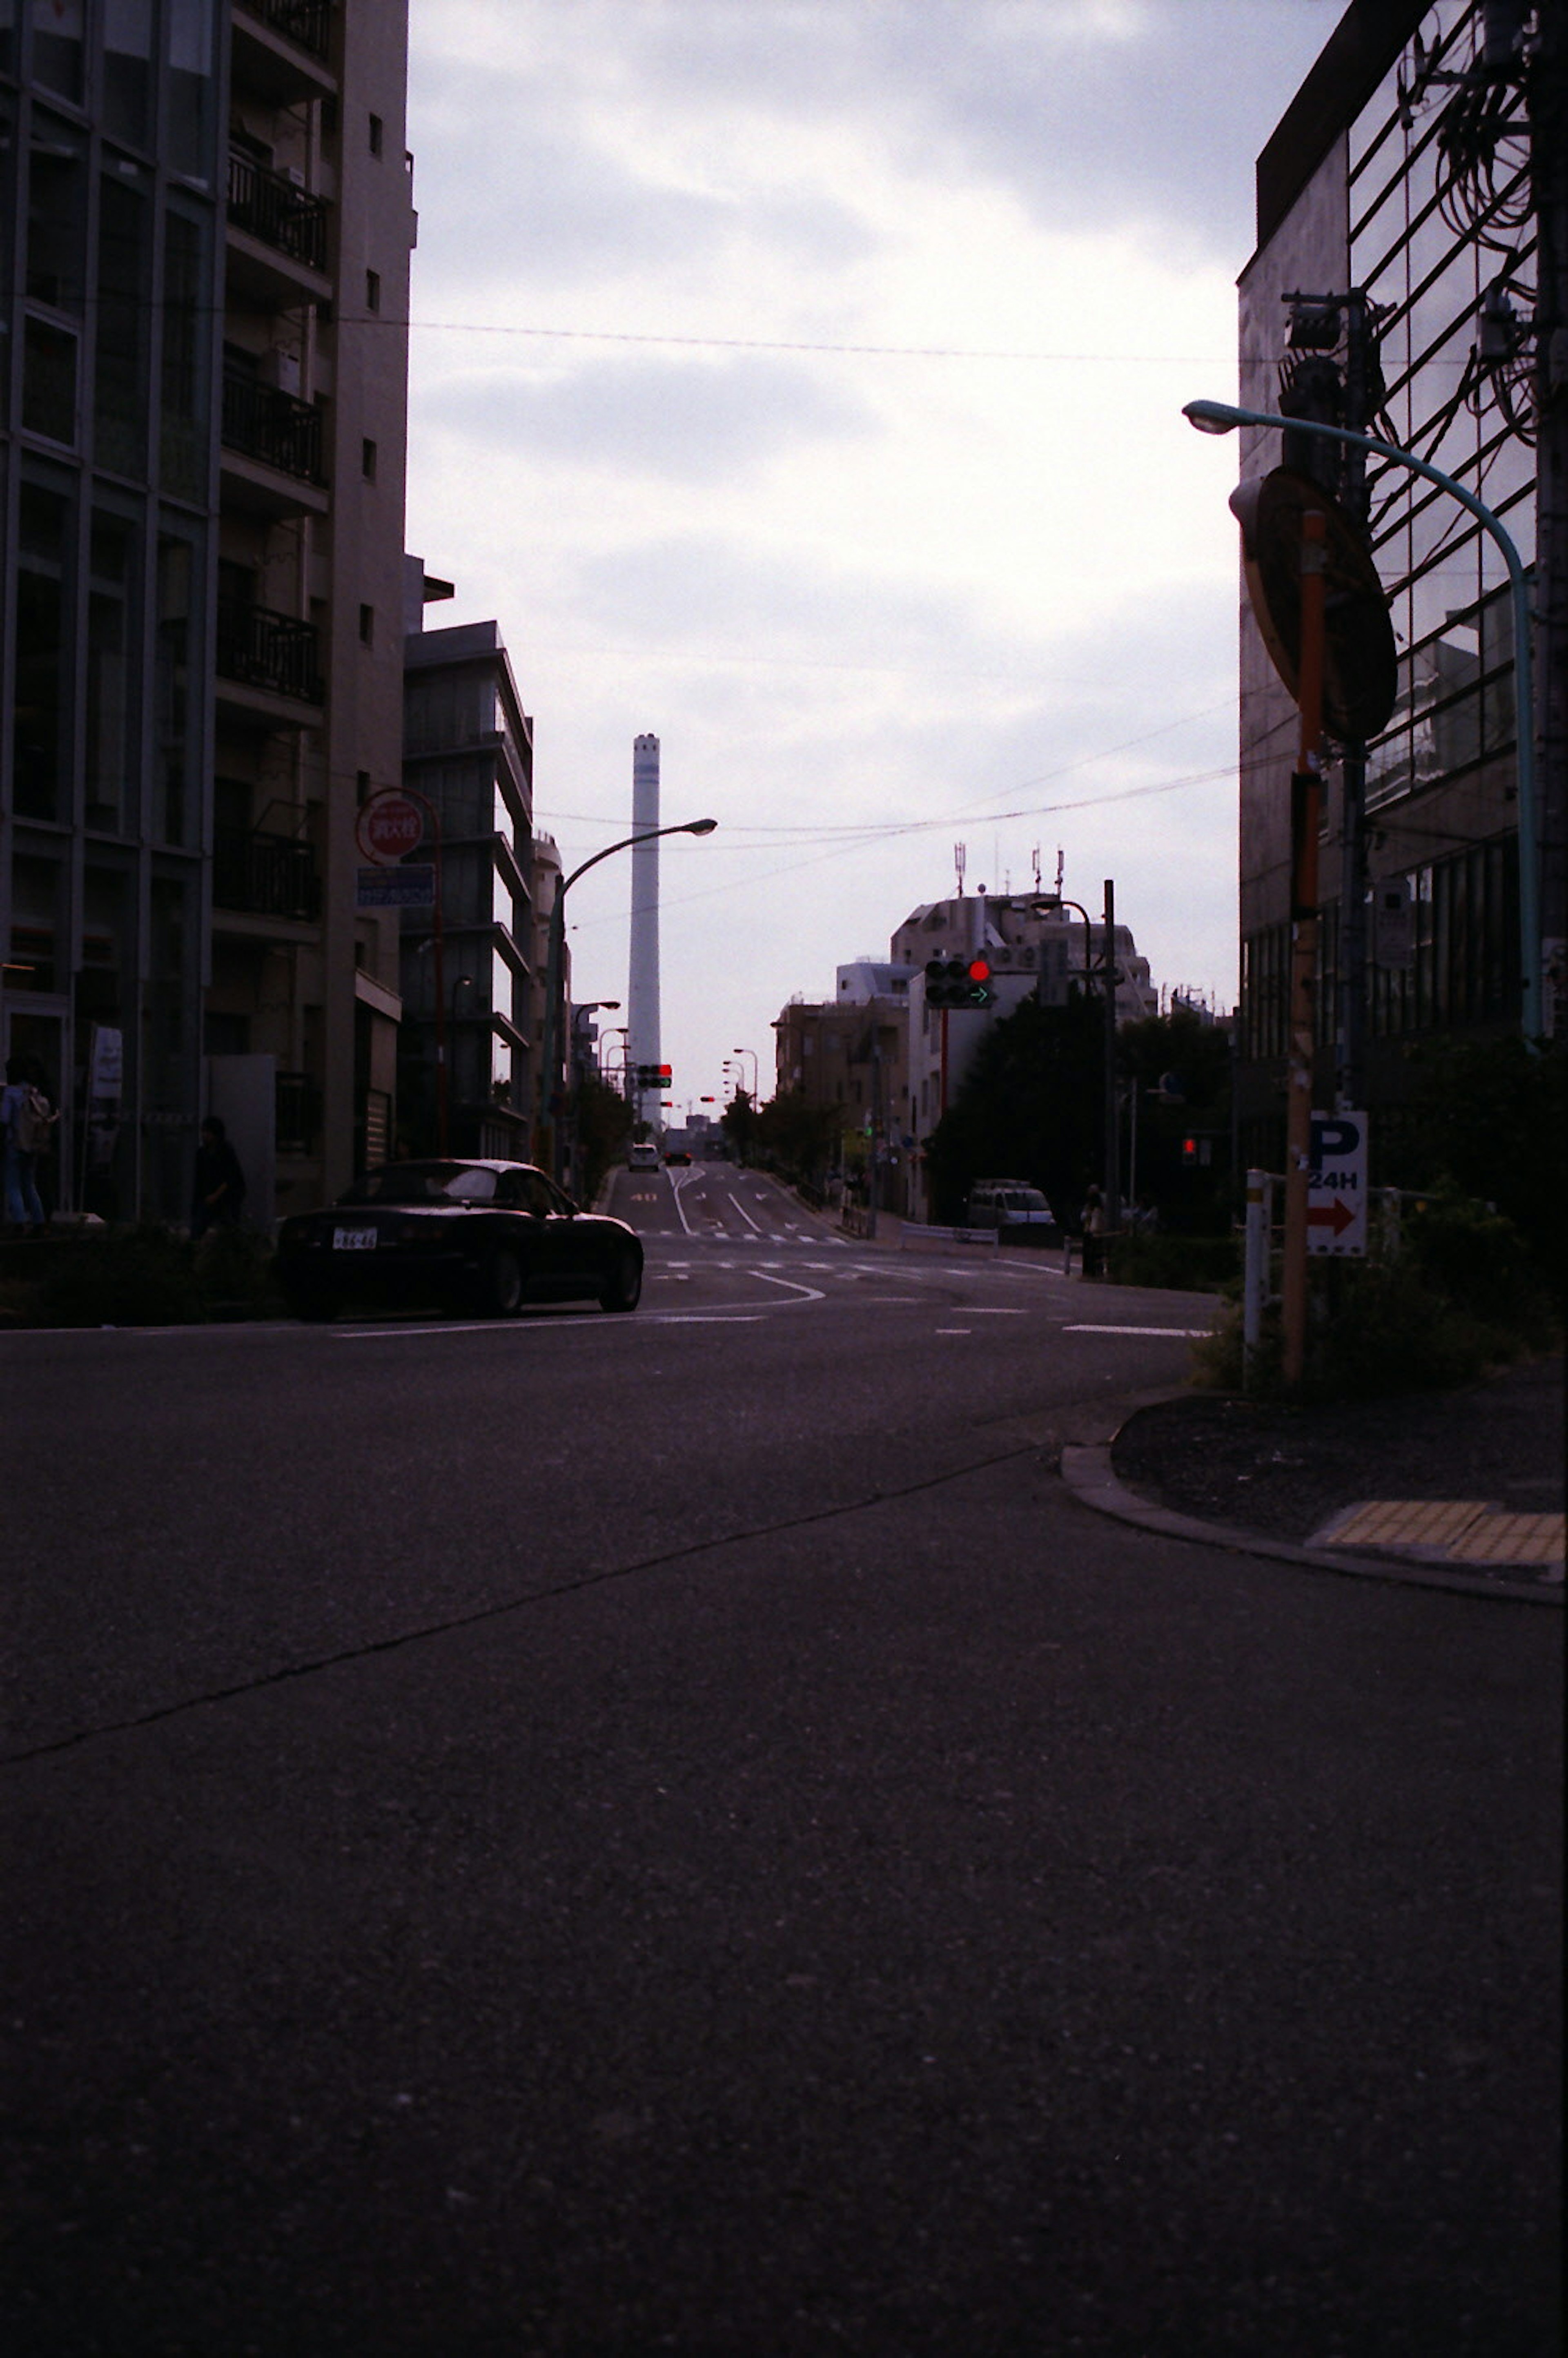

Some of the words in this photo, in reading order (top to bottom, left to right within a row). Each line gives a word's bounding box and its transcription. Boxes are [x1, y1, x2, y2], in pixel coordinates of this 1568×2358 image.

[1312, 1121, 1359, 1170] P
[1309, 1172, 1357, 1189] 24H
[630, 1192, 657, 1201] 40
